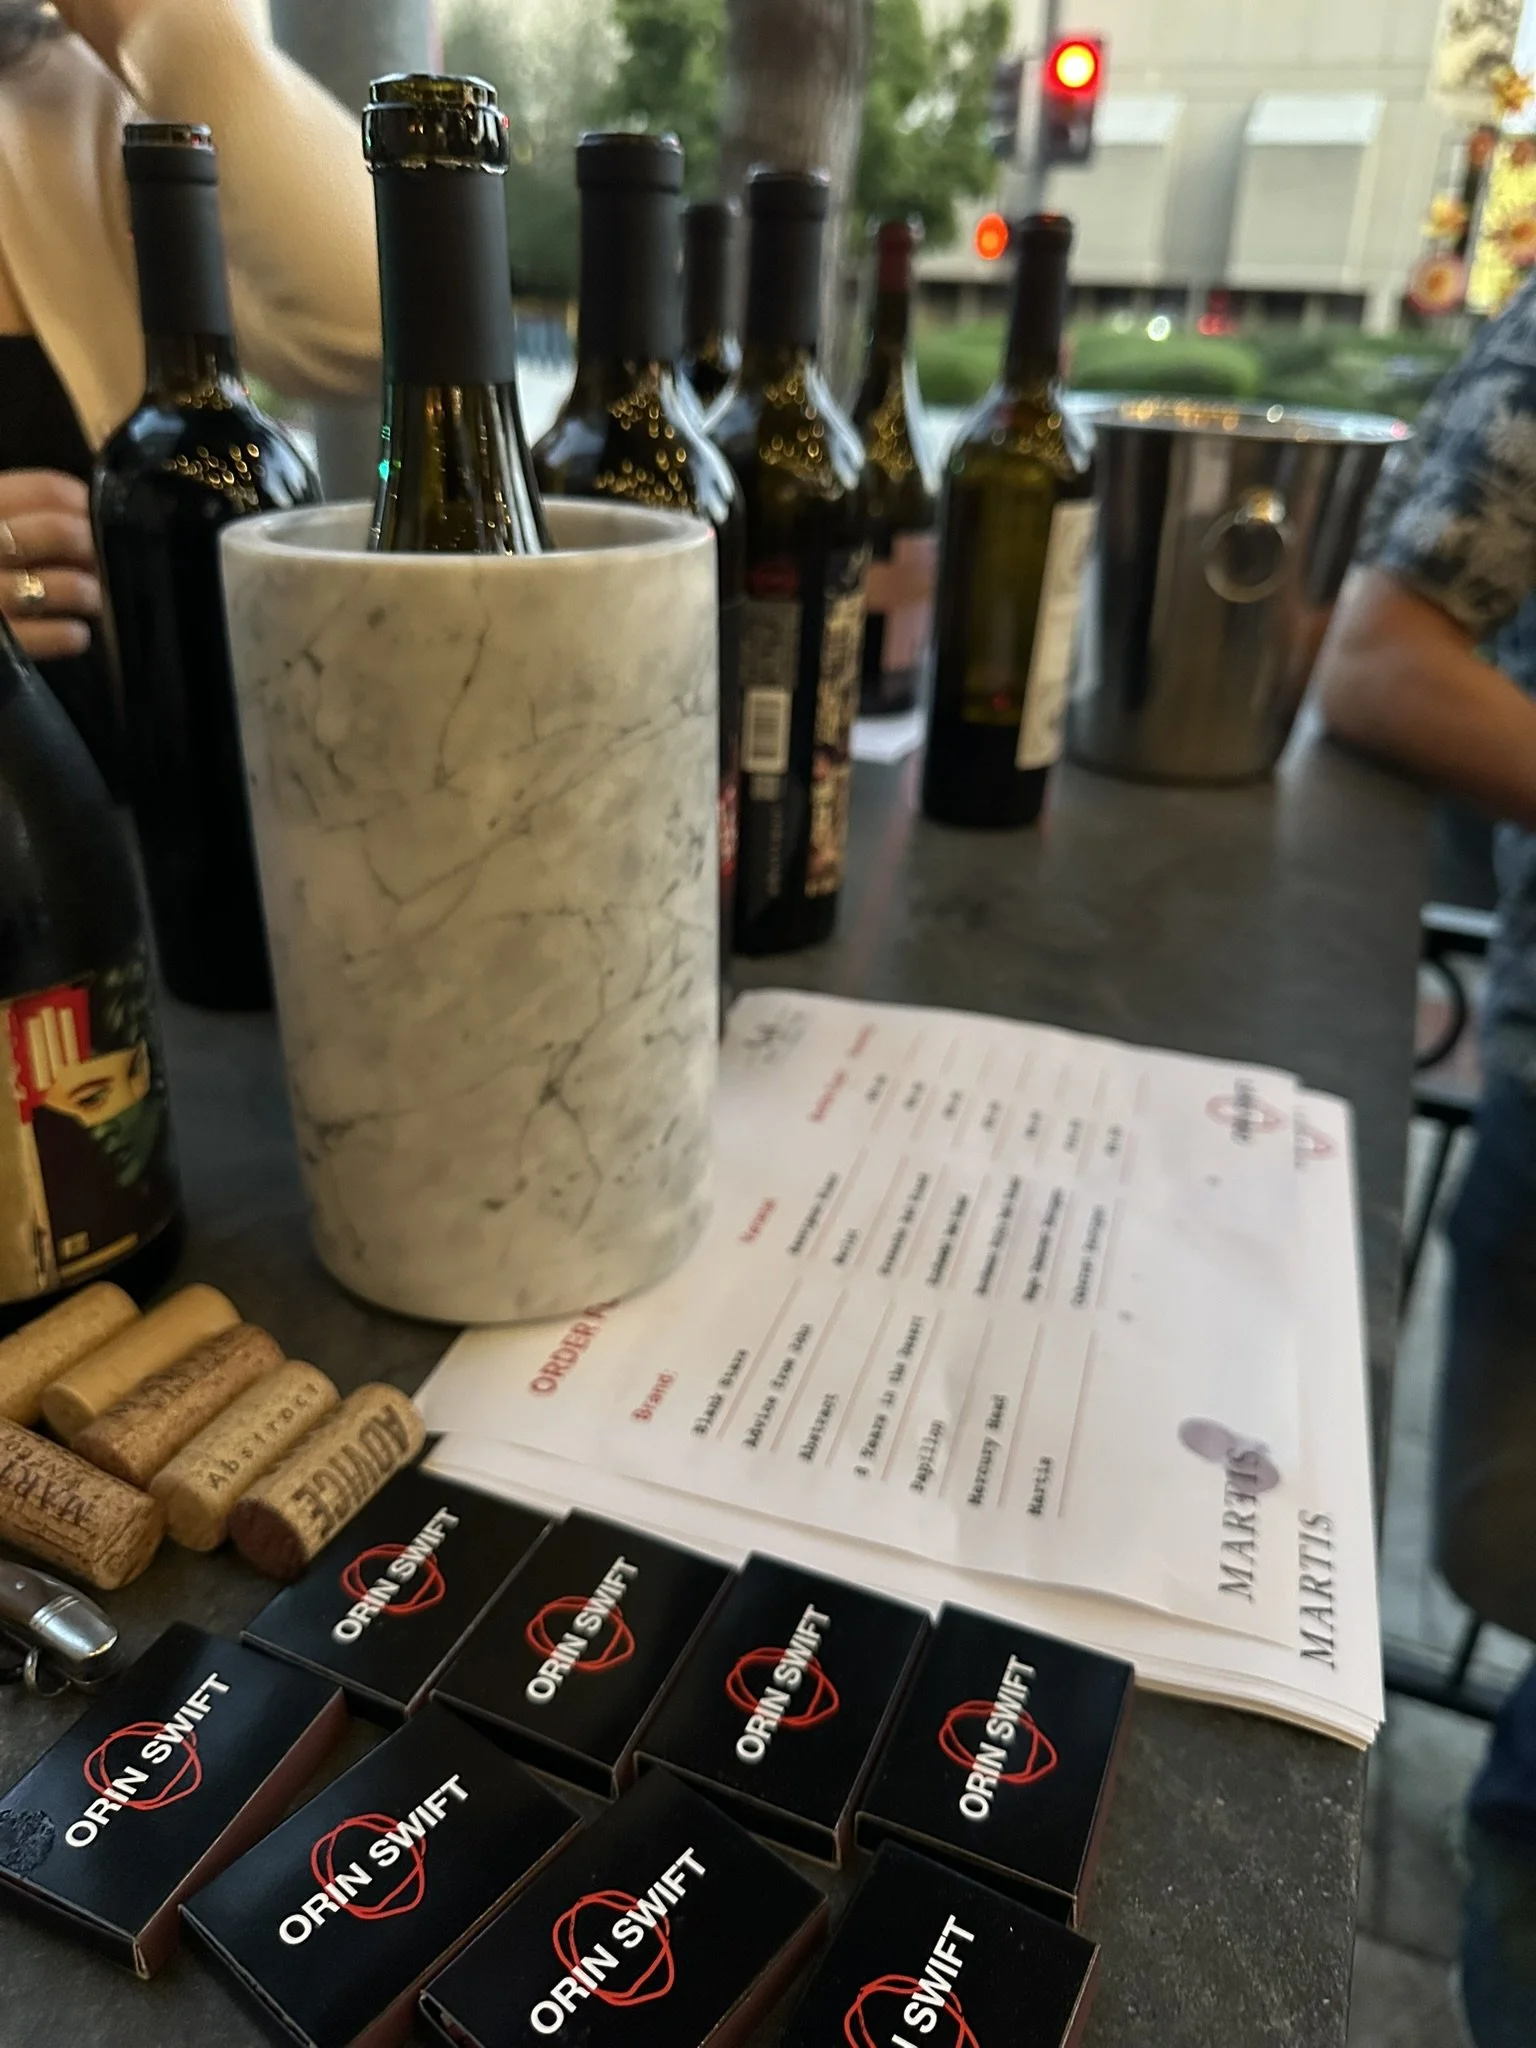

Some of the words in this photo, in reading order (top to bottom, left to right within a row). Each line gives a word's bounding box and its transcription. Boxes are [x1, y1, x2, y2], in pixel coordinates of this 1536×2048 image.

[529, 1322, 598, 1396] ORDER
[860, 1414, 888, 1460] Years
[881, 1390, 897, 1408] in
[889, 1362, 906, 1384] the
[207, 1382, 319, 1491] Abstract
[292, 1404, 409, 1539] ADVICE
[798, 1394, 839, 1463] Abstract
[909, 1419, 947, 1493] Papillon
[967, 1436, 1001, 1505] Mercury
[1027, 1456, 1054, 1516] Martis
[331, 1576, 400, 1643] ORIN
[388, 1506, 459, 1582] SWIFT
[1218, 1447, 1259, 1603] MARTIS
[1300, 1508, 1336, 1670] MARTIS
[526, 1631, 588, 1703] ORIN
[573, 1555, 639, 1635] SWIFT
[735, 1685, 790, 1763] ORIN
[772, 1603, 831, 1690] SWIFT
[64, 1765, 150, 1848] ORIN
[141, 1672, 230, 1767] SWIFT
[958, 1740, 1007, 1821] ORIN
[984, 1653, 1036, 1743] SWIFT
[278, 1861, 373, 1946] ORIN
[368, 1774, 469, 1868] SWIFT
[530, 1943, 620, 2035] ORIN
[611, 1846, 706, 1949] SWIFT
[903, 1914, 975, 2034] SWIFT
